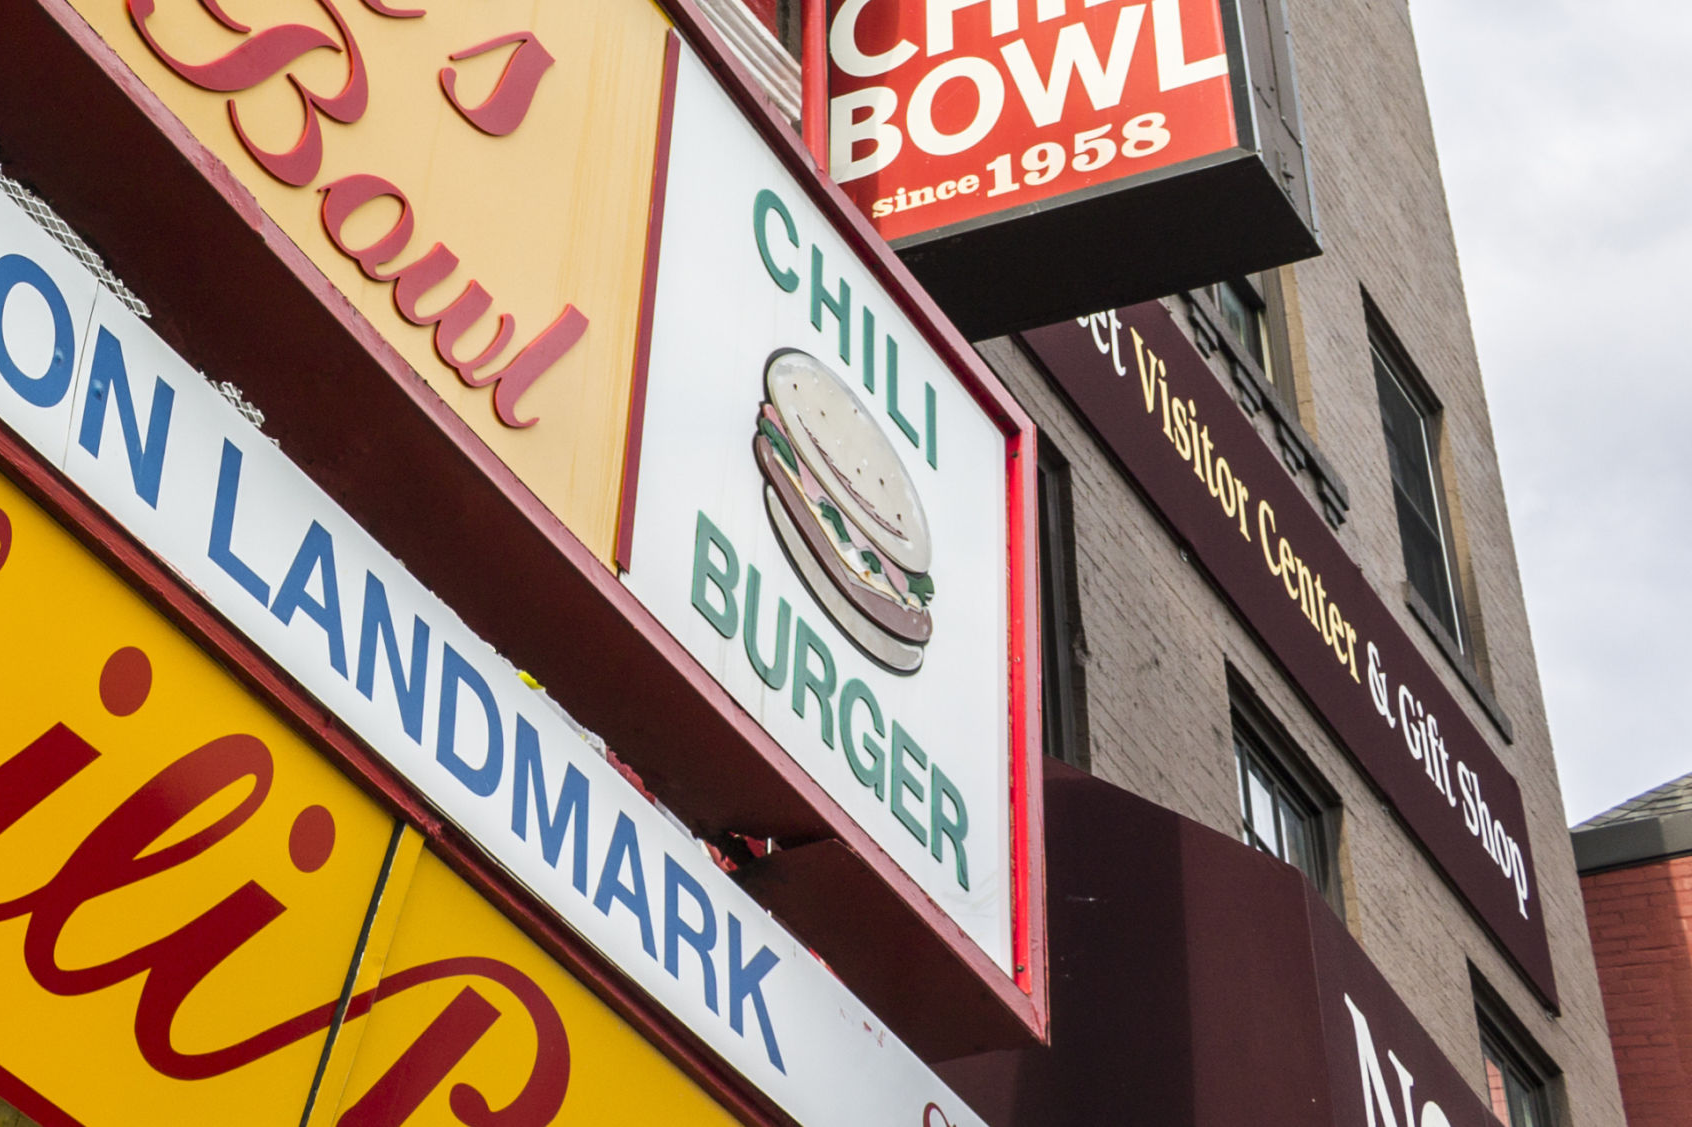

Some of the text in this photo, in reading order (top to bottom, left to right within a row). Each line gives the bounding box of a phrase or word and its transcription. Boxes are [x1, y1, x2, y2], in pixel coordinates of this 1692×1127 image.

[753, 188, 938, 471] CHILI
[872, 112, 1172, 219] since 1958
[208, 437, 787, 1076] LANDMARK
[691, 509, 970, 892] BURGER
[1129, 326, 1529, 920] Visitor Center & Gift Shop
